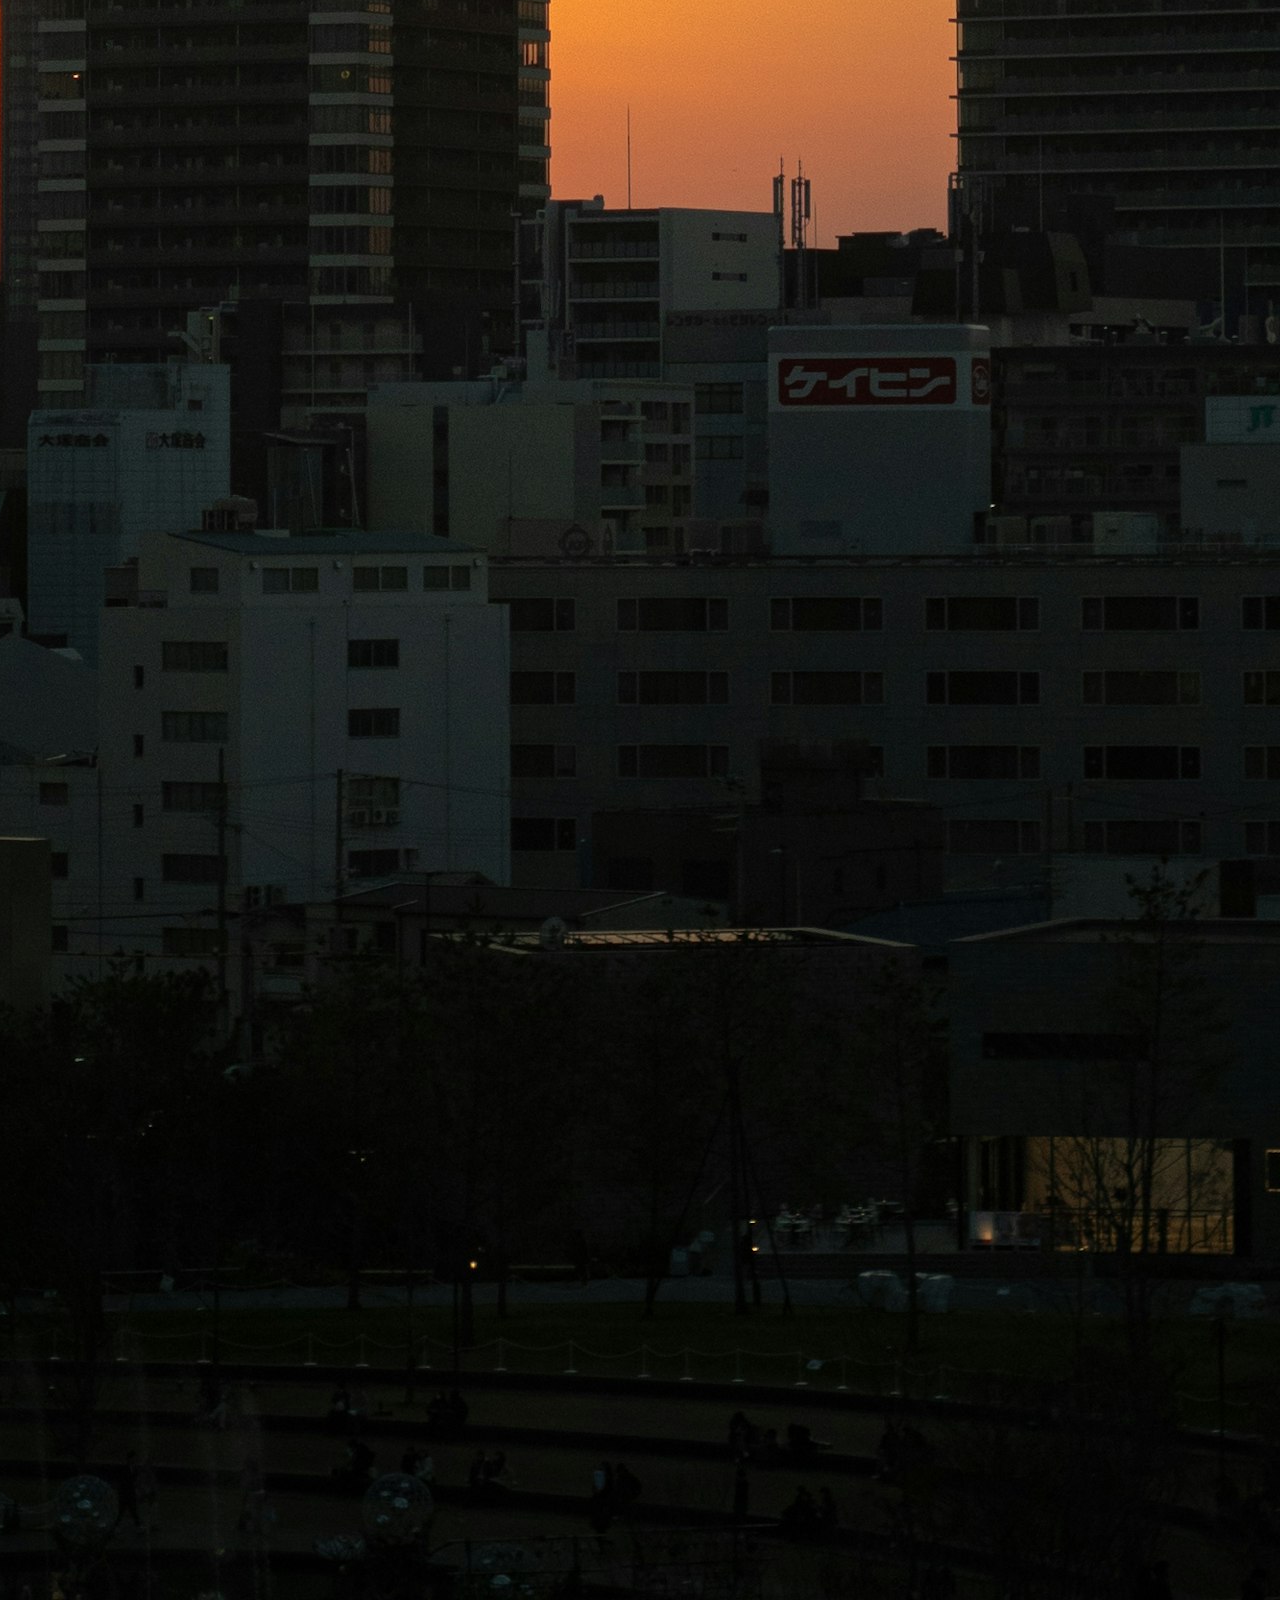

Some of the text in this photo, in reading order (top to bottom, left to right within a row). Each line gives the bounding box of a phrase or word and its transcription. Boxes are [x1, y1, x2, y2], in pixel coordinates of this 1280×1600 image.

[783, 365, 952, 399] ケイヒン
[1246, 404, 1277, 432] JT
[38, 432, 110, 448] 大塚商会
[158, 431, 206, 450] 大塚商会
